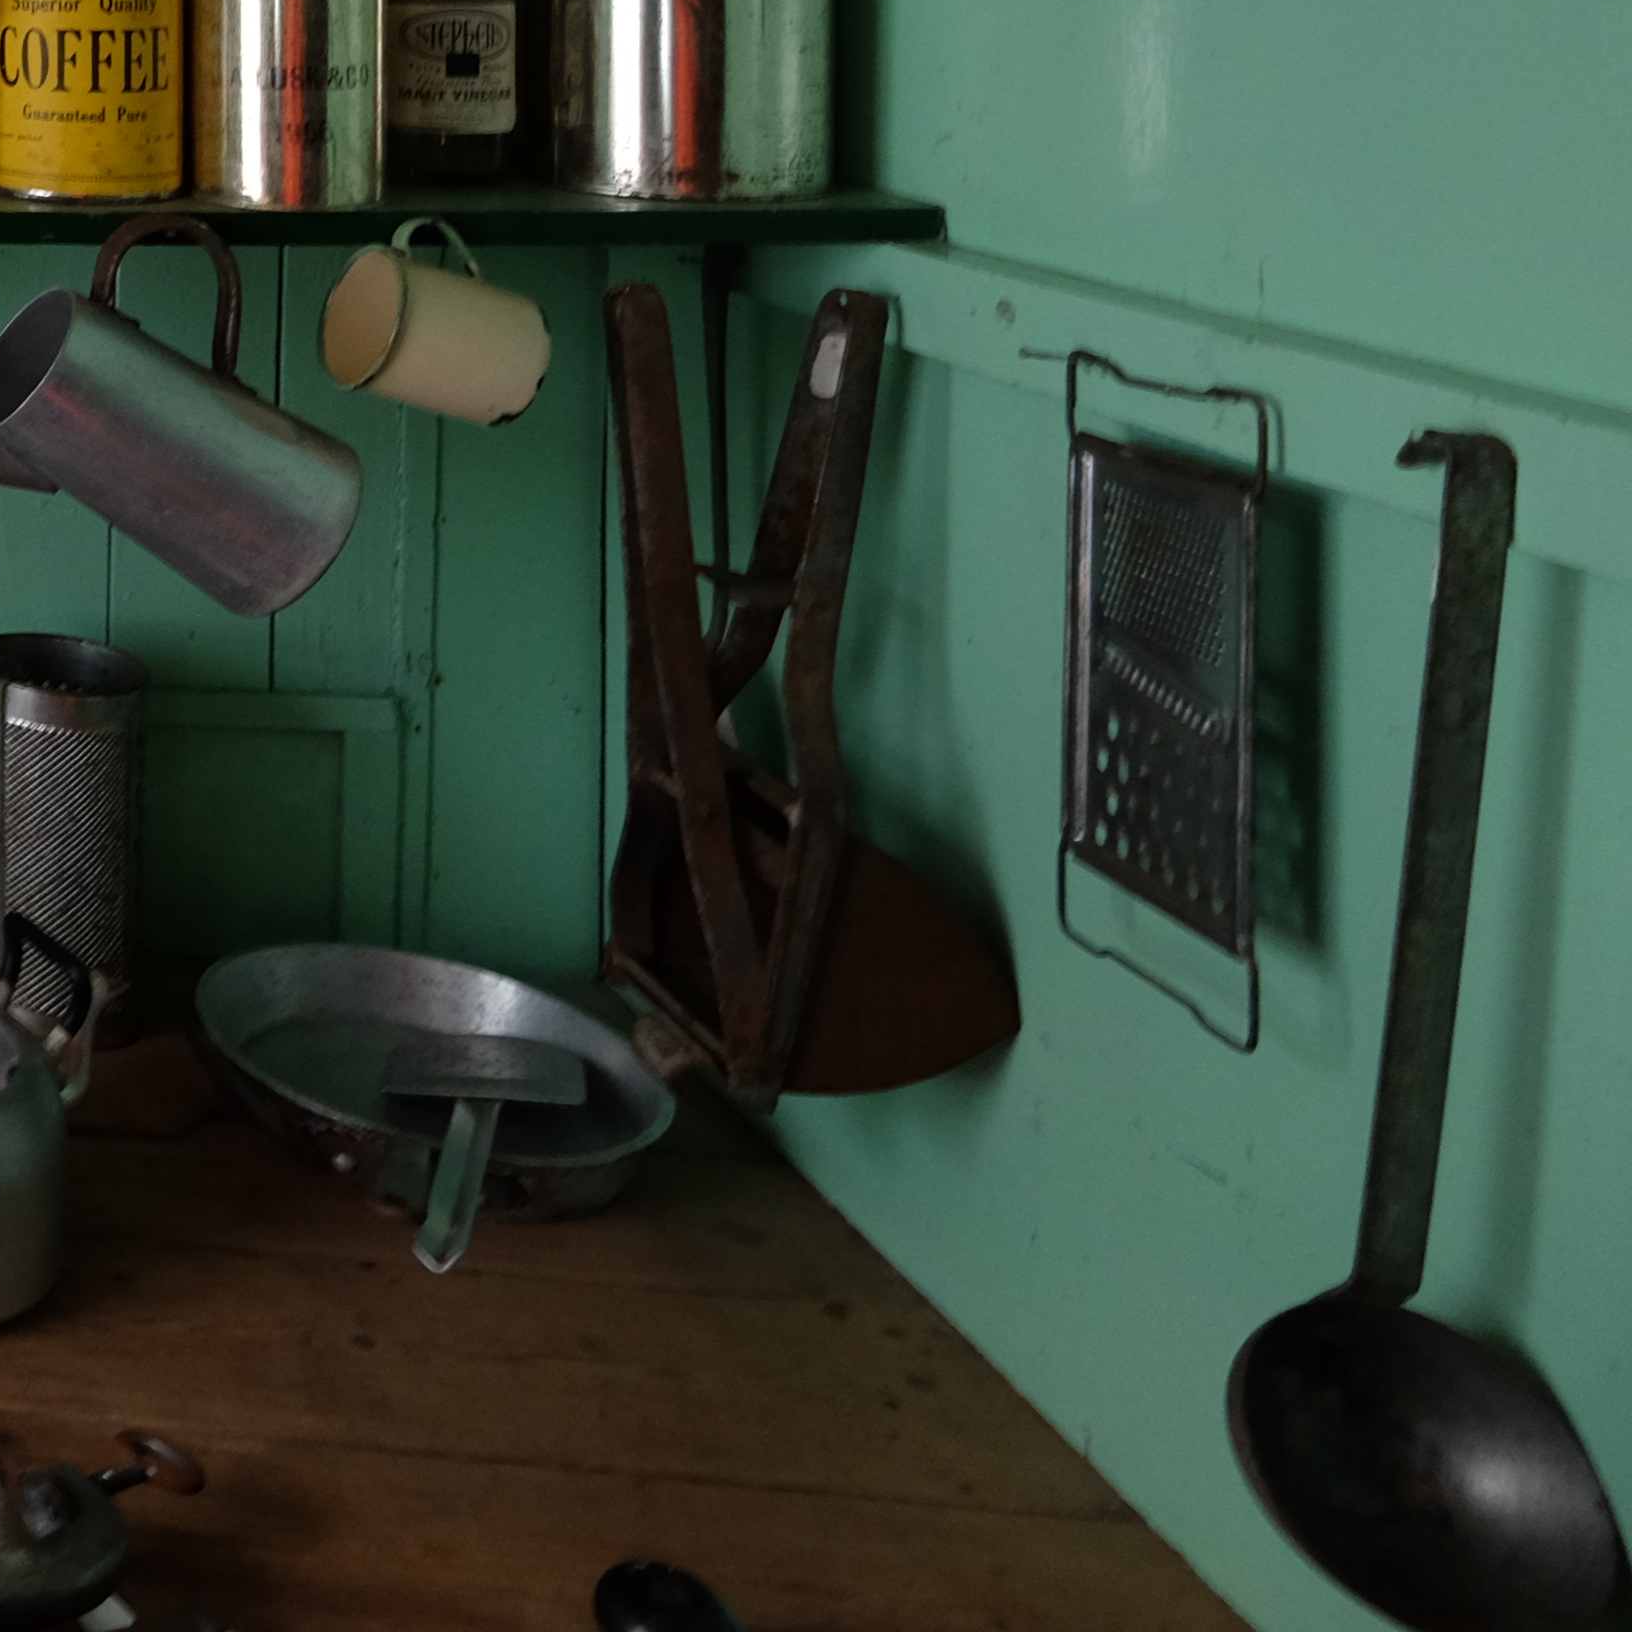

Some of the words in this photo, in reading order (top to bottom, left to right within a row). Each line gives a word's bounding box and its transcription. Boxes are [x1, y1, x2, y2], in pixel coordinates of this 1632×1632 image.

[0, 25, 169, 93] COFFEE
[22, 103, 106, 124] Guaranteed
[117, 105, 148, 124] Pure
